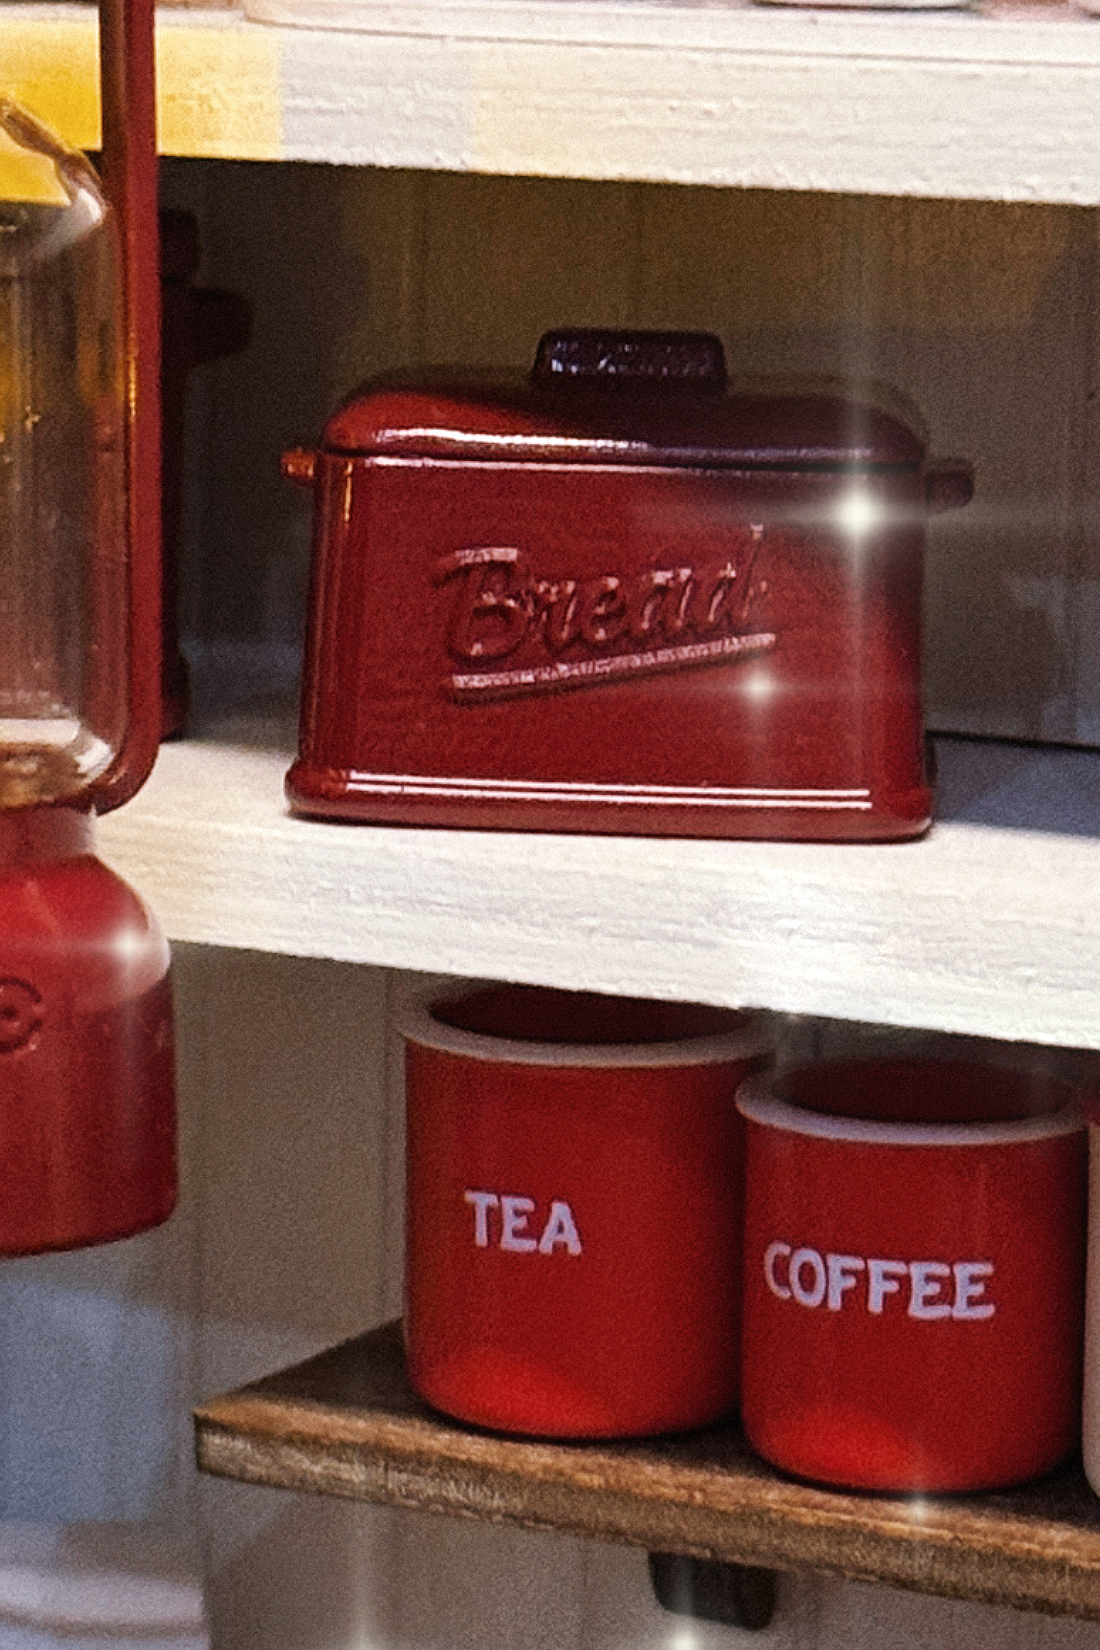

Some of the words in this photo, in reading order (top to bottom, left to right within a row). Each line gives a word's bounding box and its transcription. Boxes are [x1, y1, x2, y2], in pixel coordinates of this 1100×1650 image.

[436, 522, 772, 667] Bread
[464, 1189, 582, 1255] TEA
[764, 1240, 996, 1320] COFFEE
